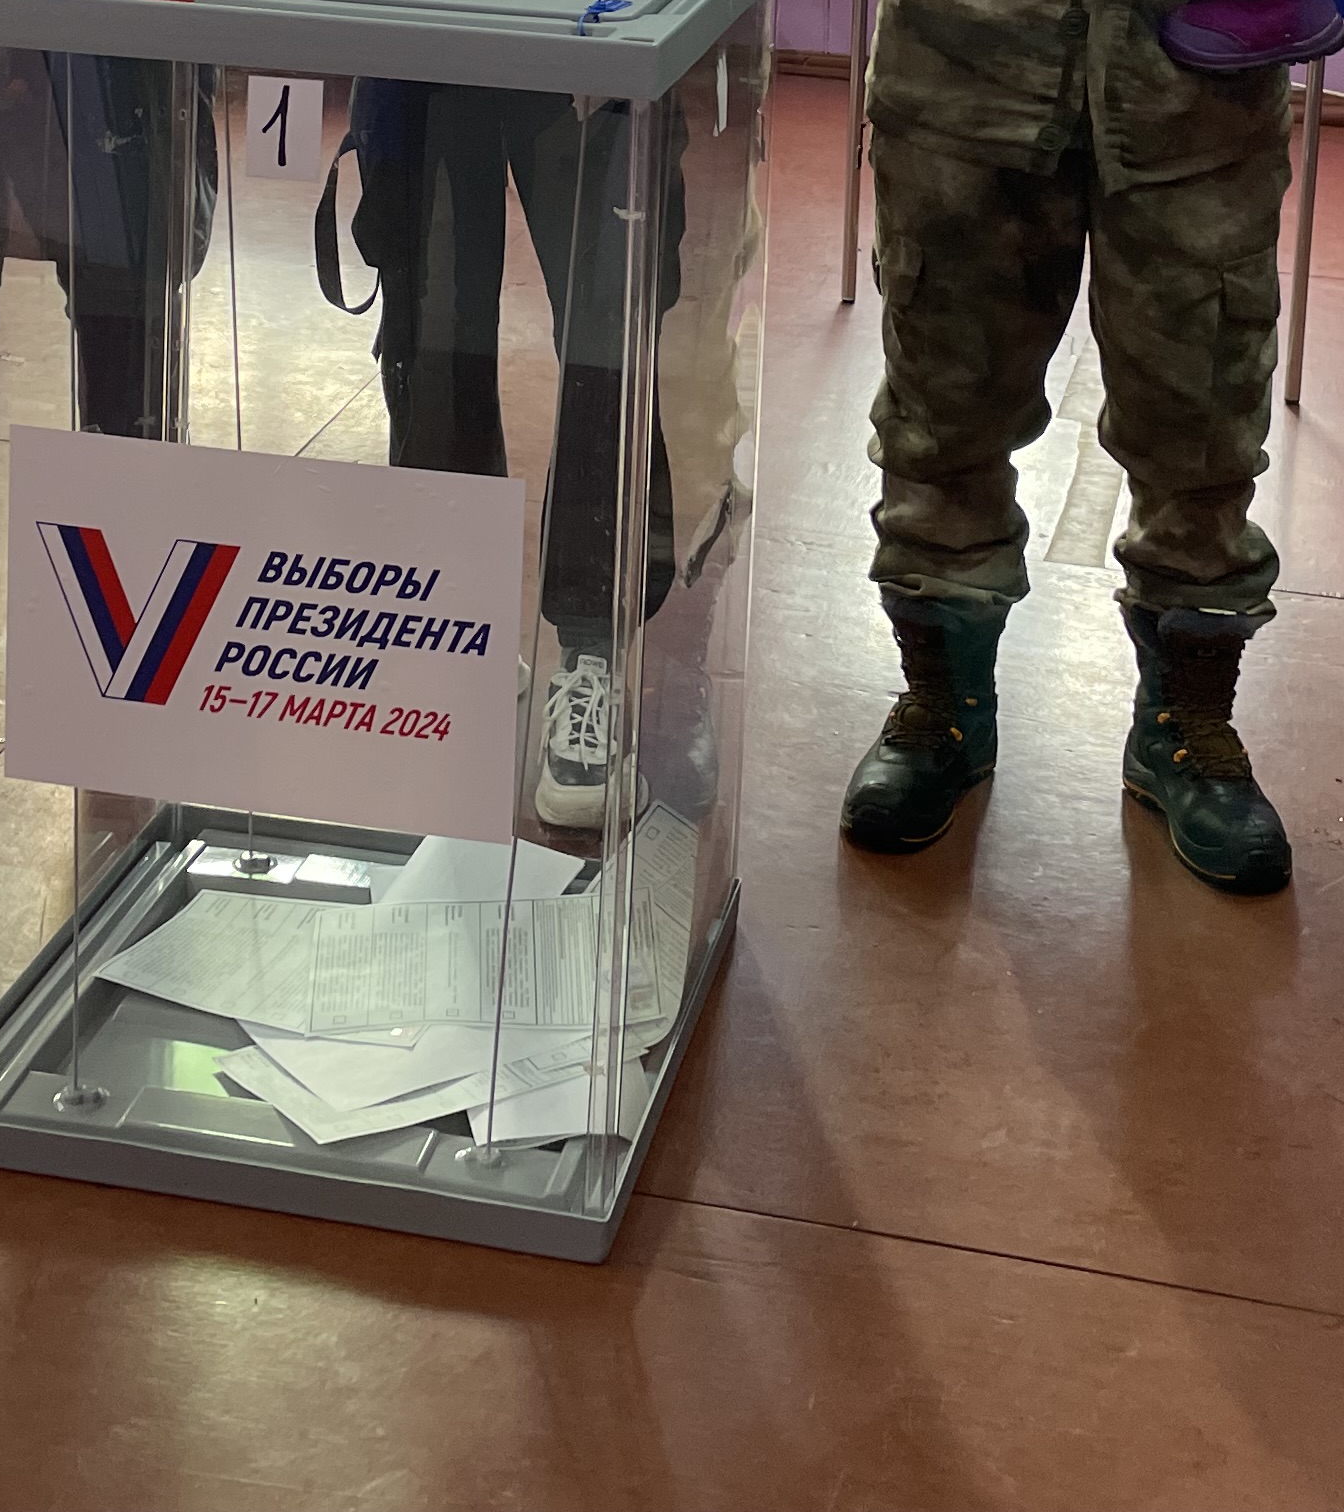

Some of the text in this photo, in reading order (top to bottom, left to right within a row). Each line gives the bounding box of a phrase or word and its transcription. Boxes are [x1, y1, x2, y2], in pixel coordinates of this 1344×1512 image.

[261, 85, 290, 167] 1
[257, 550, 441, 602] ВЫБОРЫ
[235, 596, 492, 657] ПРЕЗИДЕНТА
[214, 641, 380, 691] РОССИИ
[278, 694, 378, 733] МАРТА
[379, 707, 452, 742] 2024
